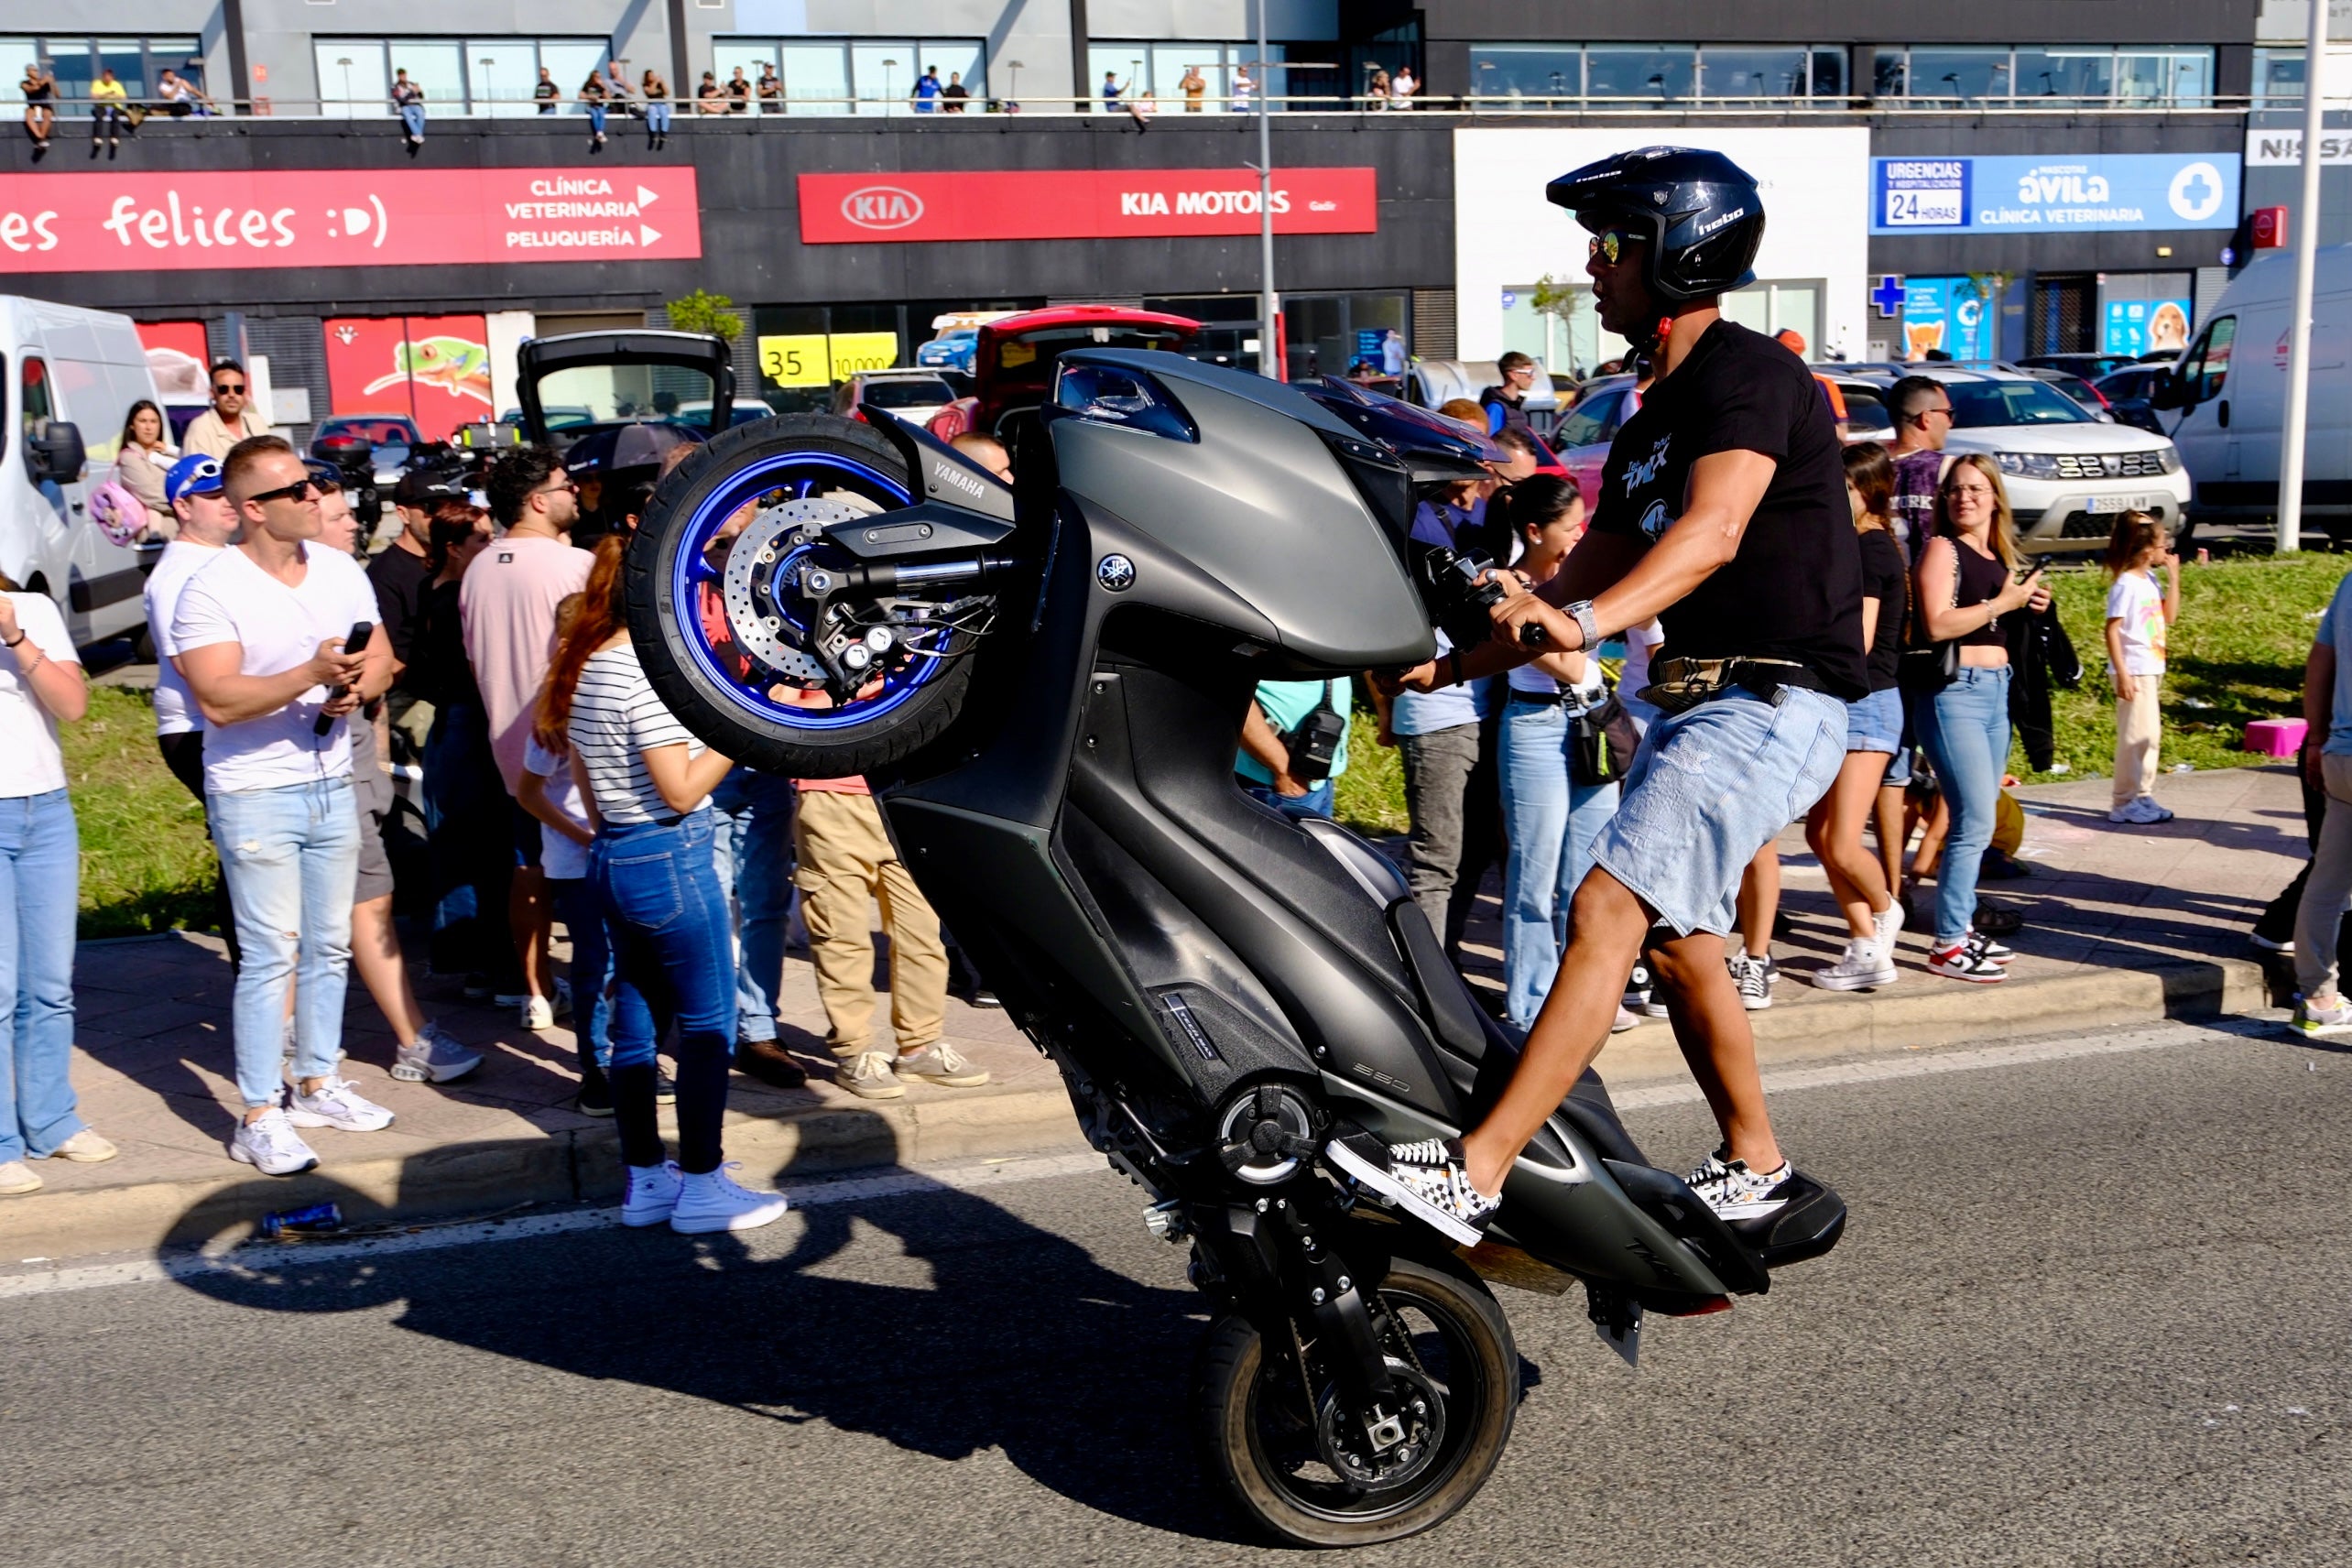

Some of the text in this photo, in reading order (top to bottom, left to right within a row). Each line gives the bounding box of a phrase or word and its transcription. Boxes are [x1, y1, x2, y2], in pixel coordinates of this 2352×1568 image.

[1887, 162, 1962, 179] URGENCIAS
[530, 176, 613, 196] CLÍNICA
[505, 201, 640, 219] VETERINARIA
[855, 195, 910, 220] KIA
[1121, 192, 1171, 215] KIA
[1892, 194, 1956, 219] 24 HORAS
[1979, 206, 2144, 224] CLÍNICA VETERINARIA
[0, 211, 59, 252] es
[103, 190, 295, 248] felices
[1698, 207, 1744, 236] hebo
[506, 226, 635, 247] PELUQUERÍA
[768, 351, 801, 376] 35
[933, 461, 985, 499] YAMAHA
[1889, 495, 1933, 510] YORK
[1180, 1011, 1214, 1057] TECH MAX
